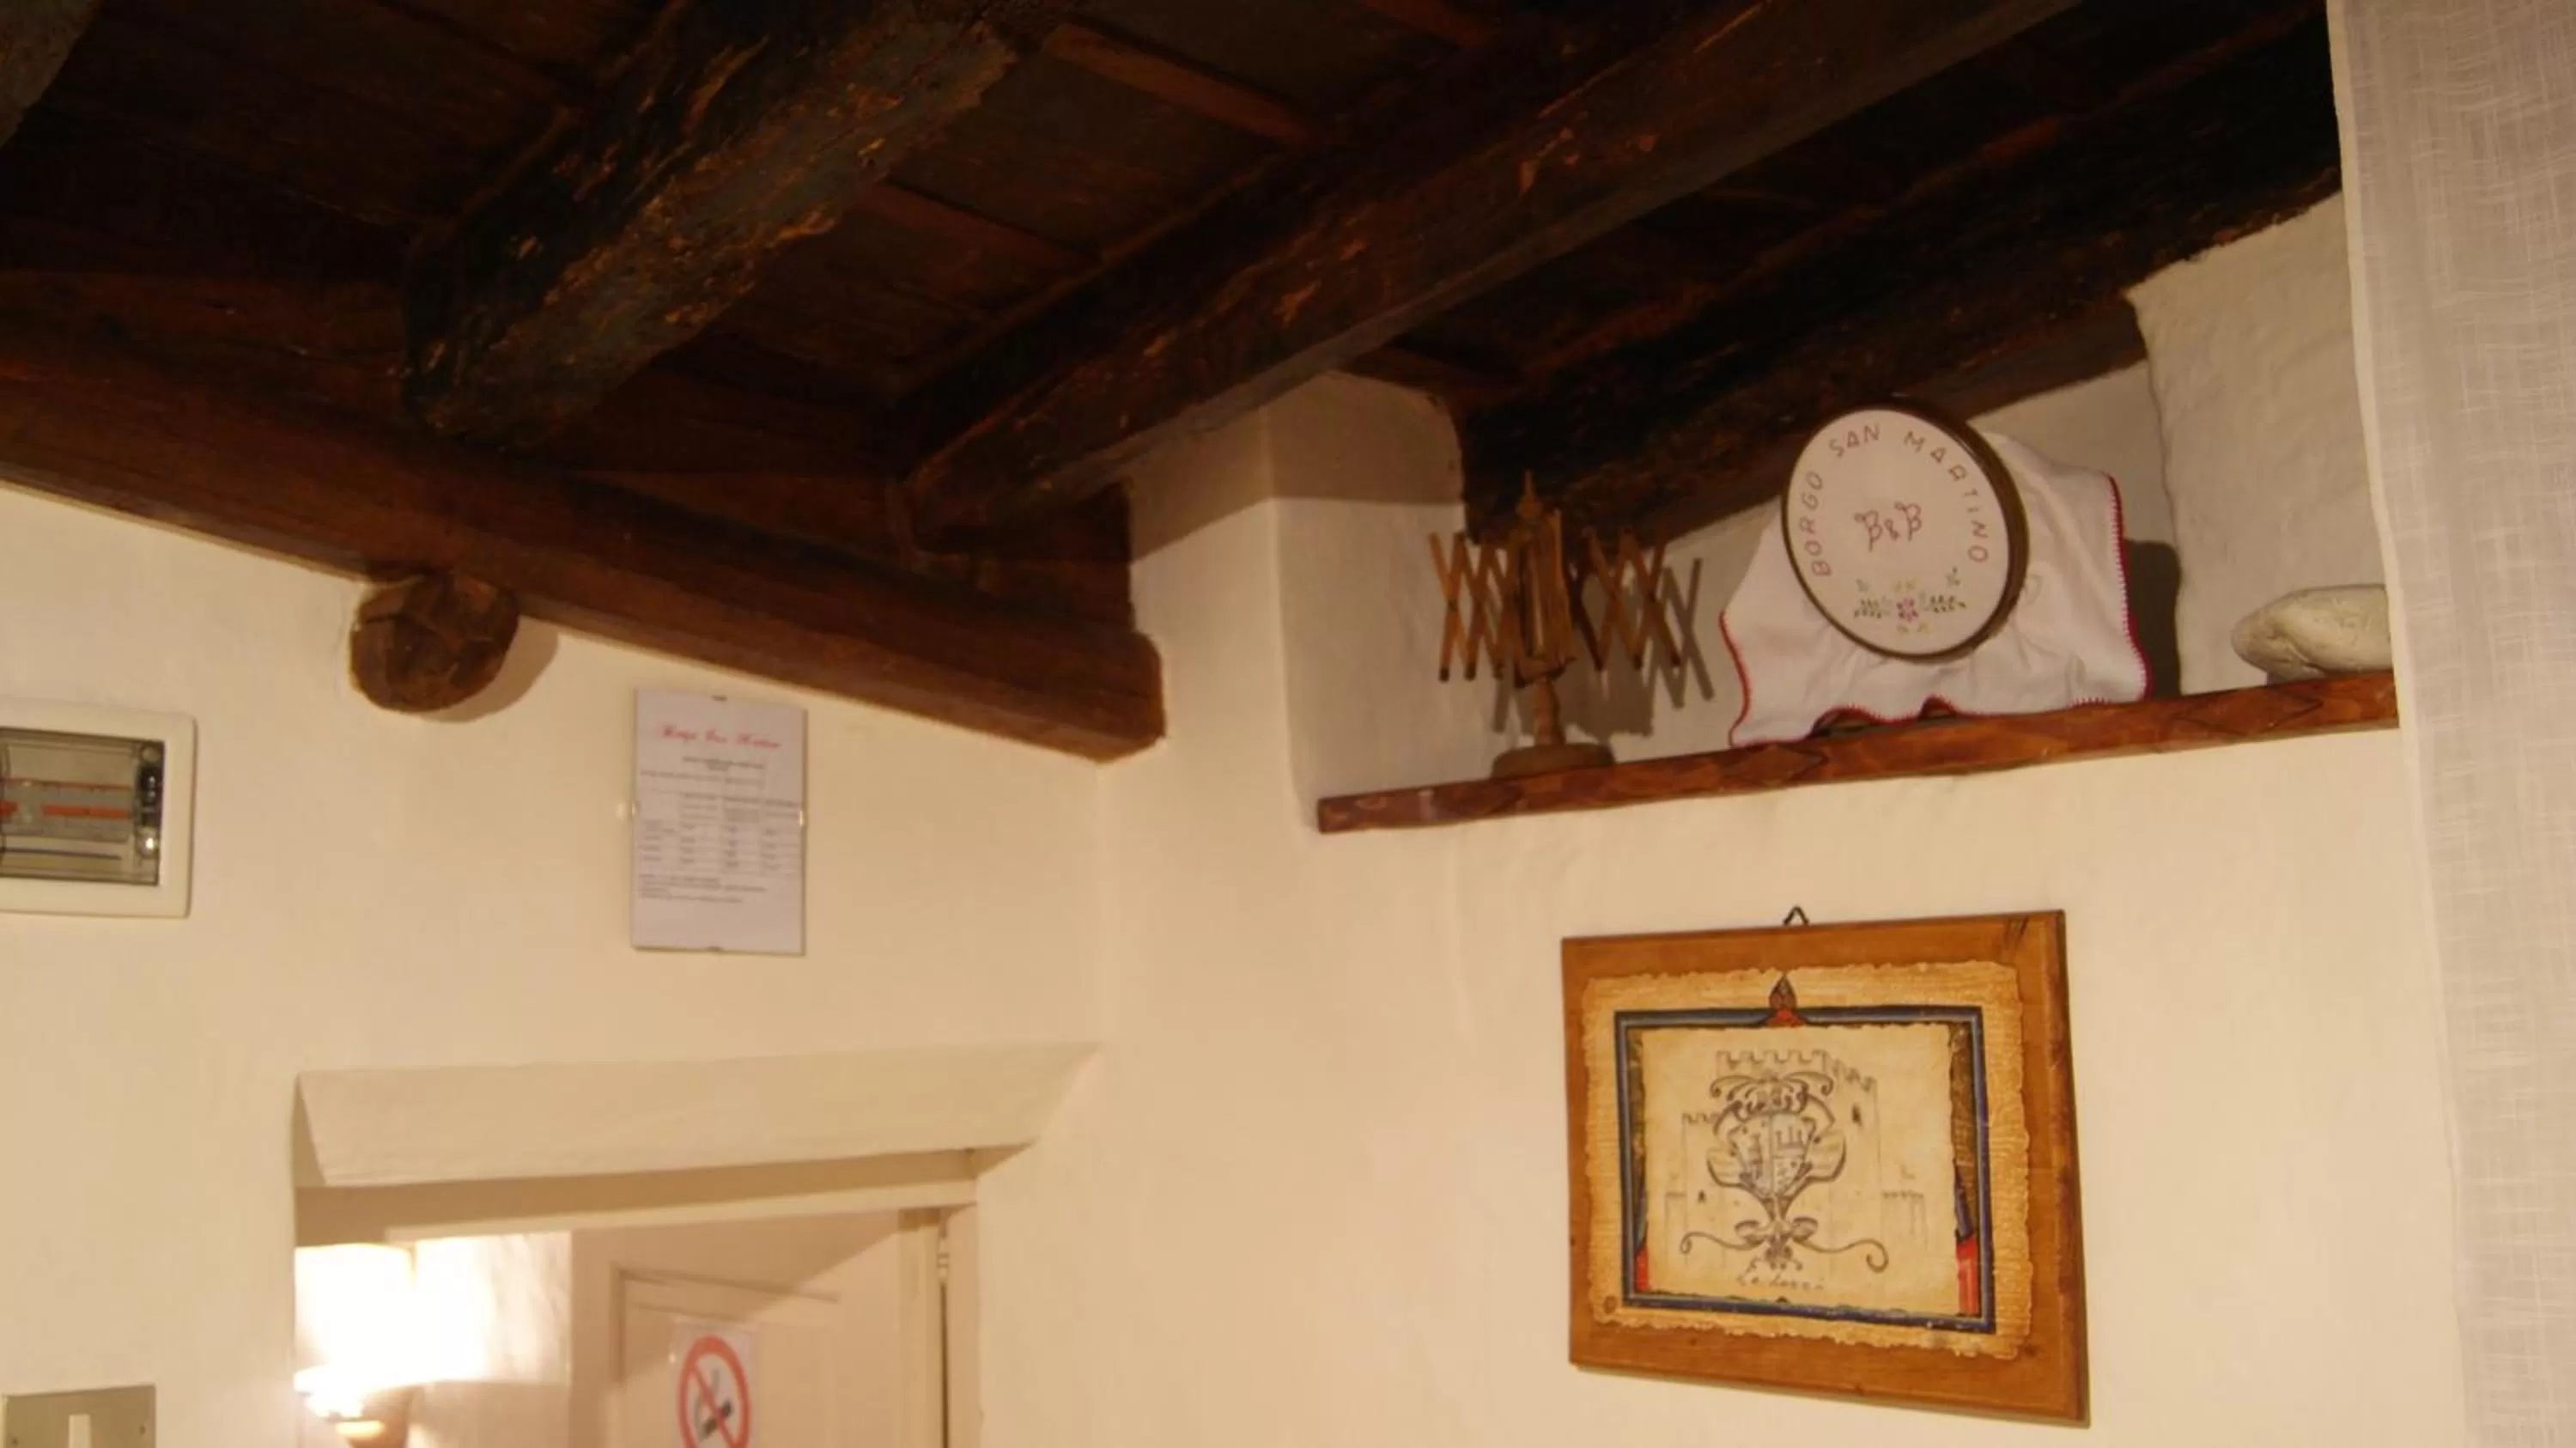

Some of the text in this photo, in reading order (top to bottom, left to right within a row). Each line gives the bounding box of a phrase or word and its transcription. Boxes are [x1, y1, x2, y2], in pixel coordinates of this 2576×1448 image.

[1798, 423, 1990, 577] BORGO SAN MARTINO
